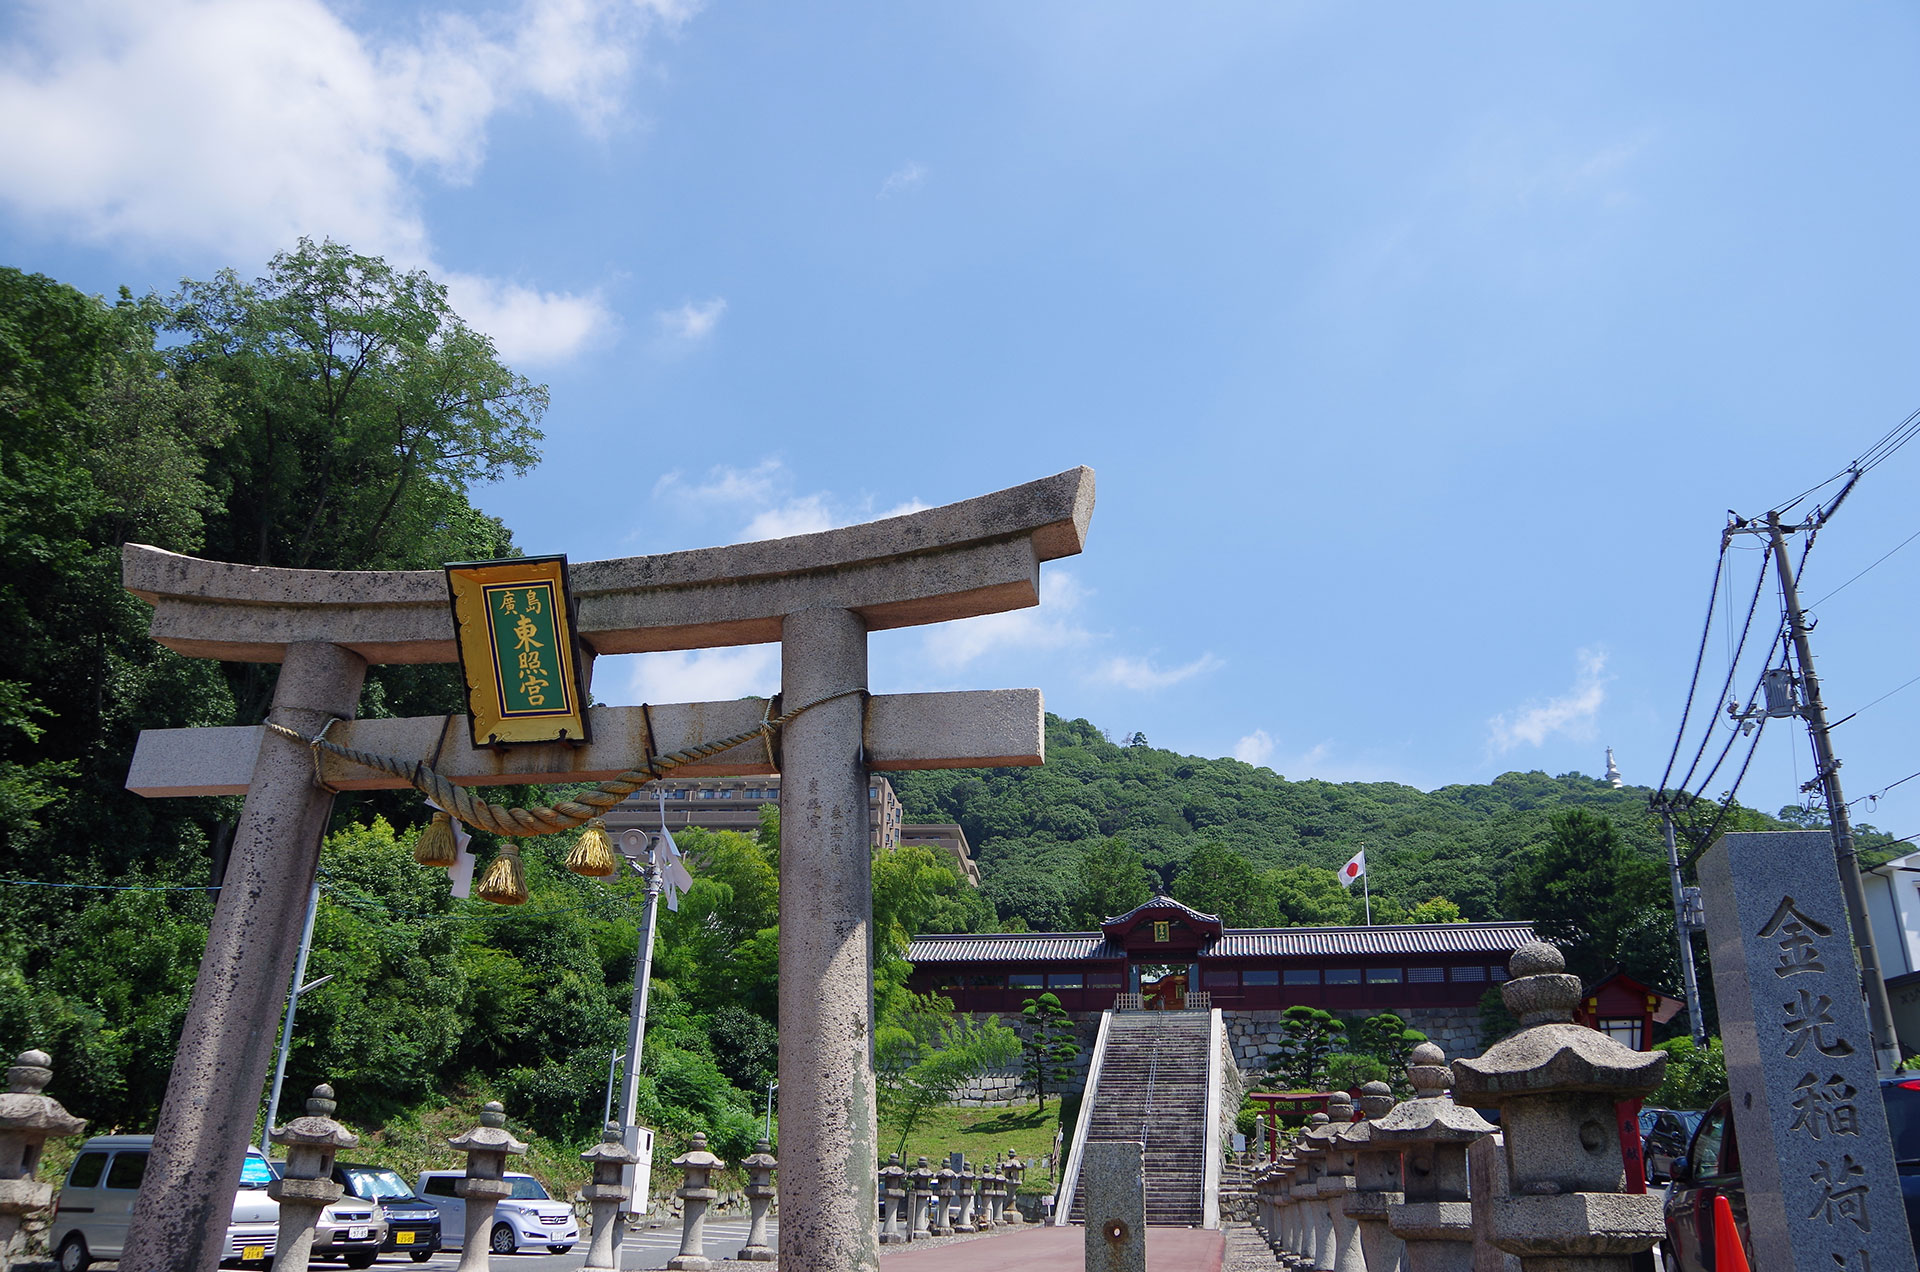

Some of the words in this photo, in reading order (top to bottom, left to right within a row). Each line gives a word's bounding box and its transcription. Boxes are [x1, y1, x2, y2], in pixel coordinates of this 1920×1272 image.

[499, 589, 542, 616] 廣島
[513, 614, 549, 706] 東照宮
[1756, 894, 1872, 1272] 金光稲荷
